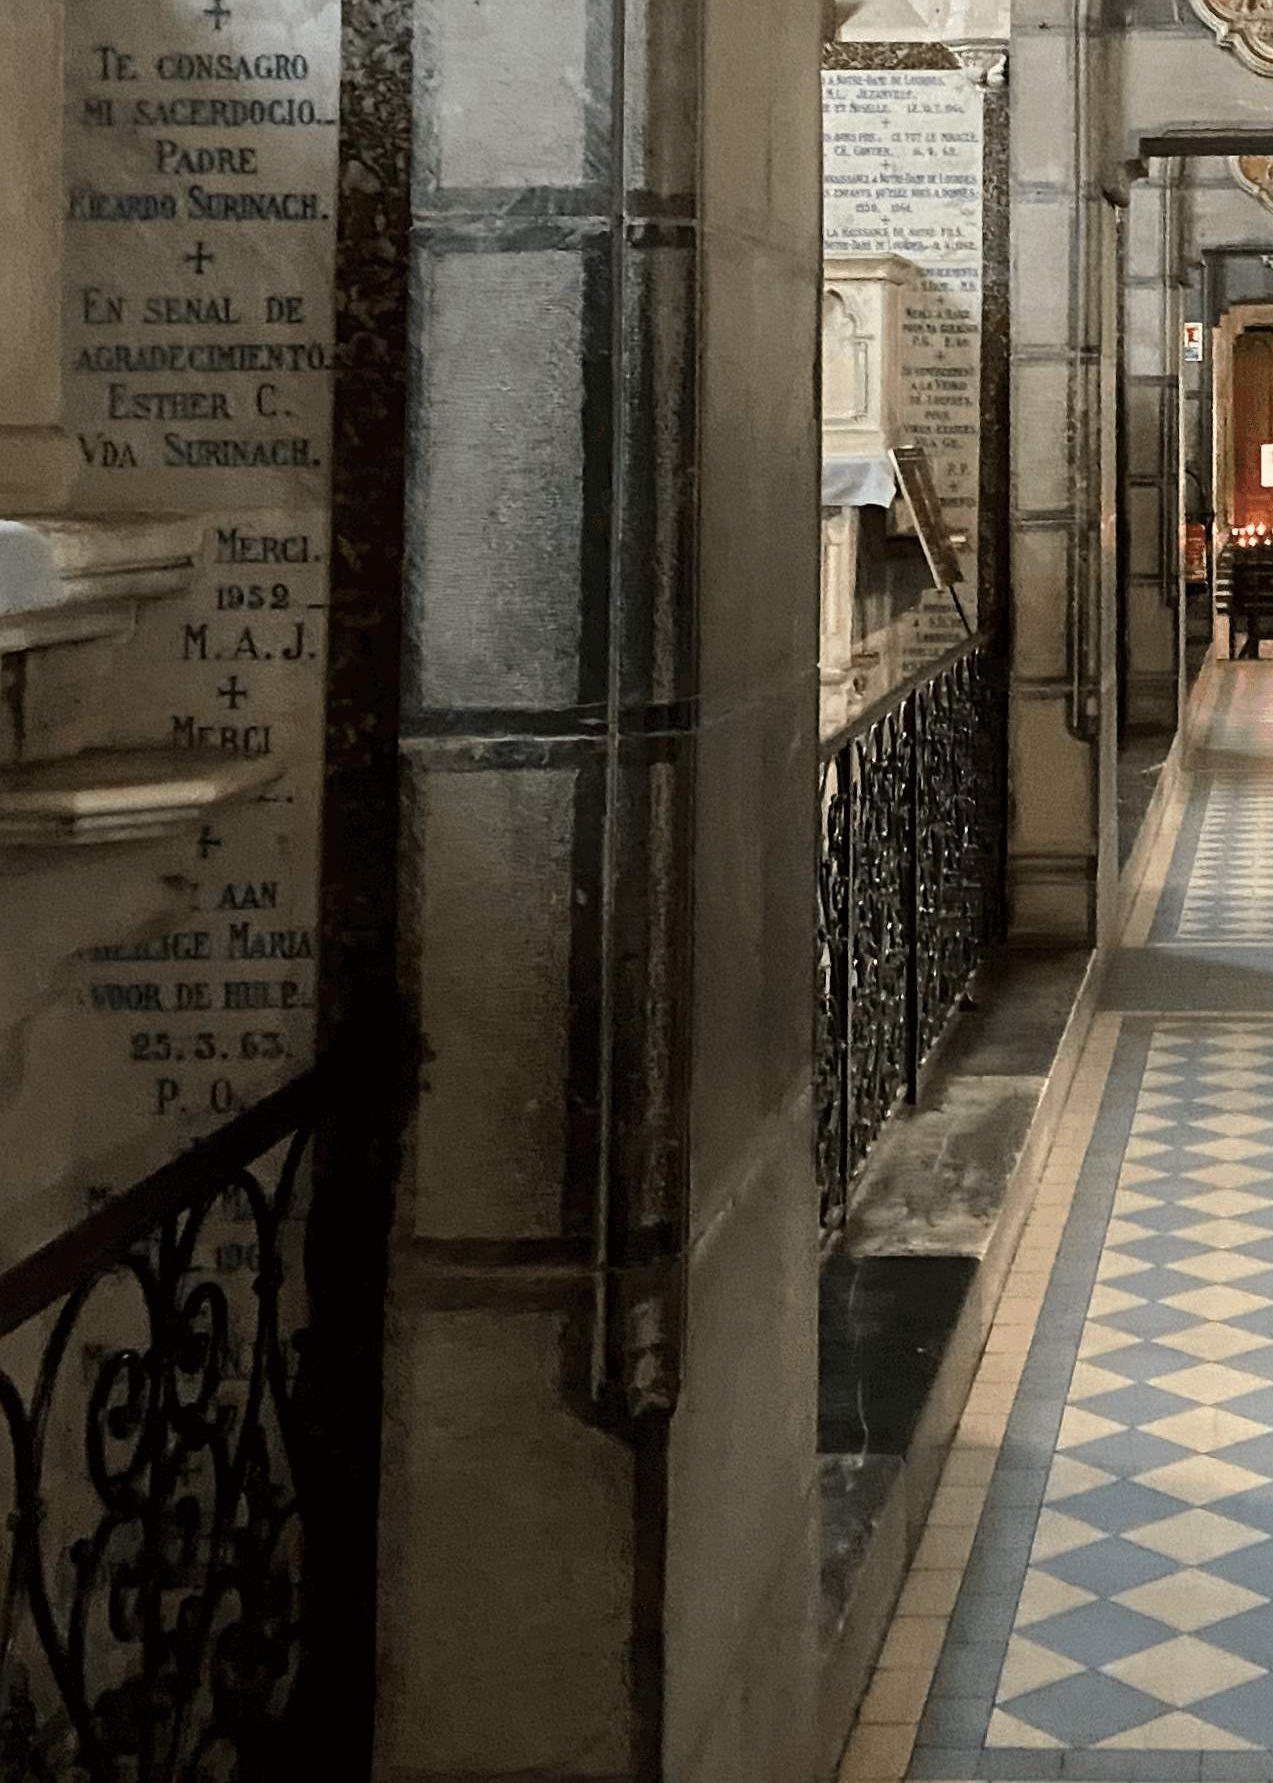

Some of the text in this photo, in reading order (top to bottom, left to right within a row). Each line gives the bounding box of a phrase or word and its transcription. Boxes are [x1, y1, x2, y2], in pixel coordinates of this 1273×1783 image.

[96, 45, 309, 82] TE CONSAGRO
[156, 139, 258, 175] PADRE
[83, 287, 123, 324] EN
[265, 296, 303, 323] DE
[108, 383, 294, 420] ESTHER C.
[78, 432, 138, 468] VDA
[215, 528, 322, 563] MERCI.
[218, 881, 278, 910] AAN
[229, 921, 316, 960] MARIA
[174, 983, 212, 1009] DE
